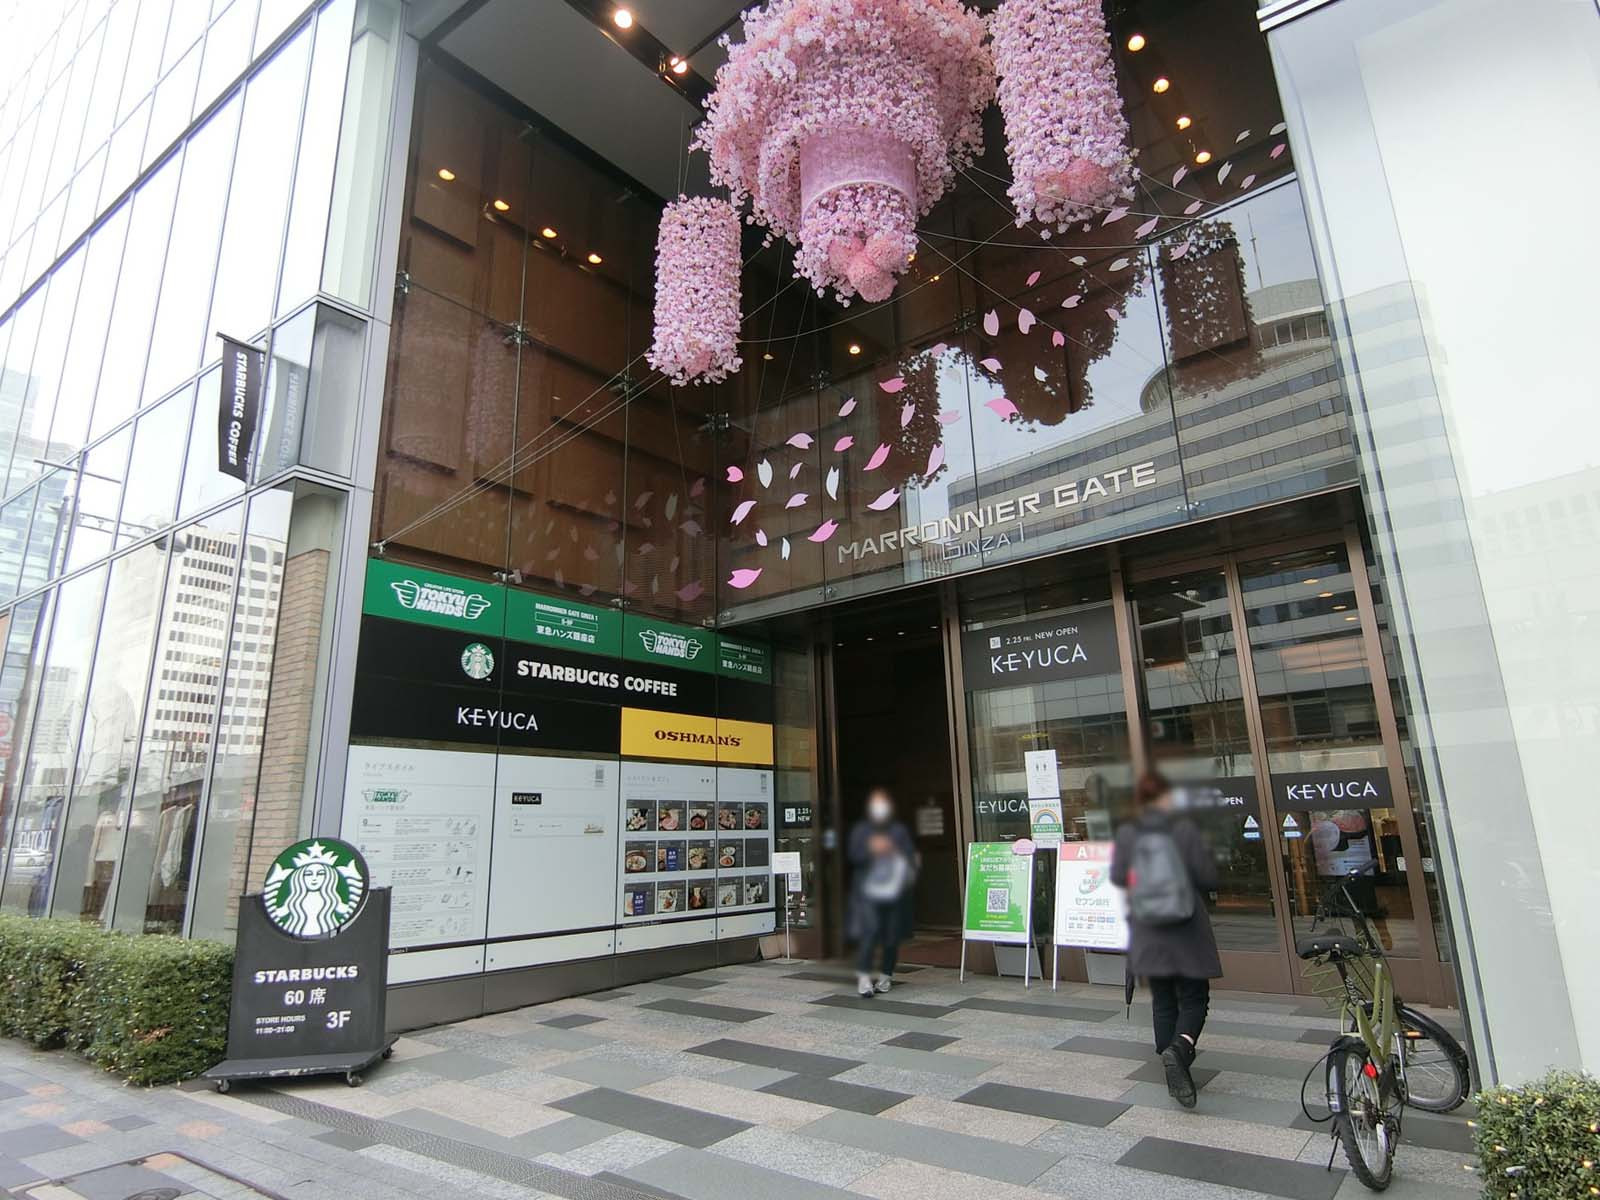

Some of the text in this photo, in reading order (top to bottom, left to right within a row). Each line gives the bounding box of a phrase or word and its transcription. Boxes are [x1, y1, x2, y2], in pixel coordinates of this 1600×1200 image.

[228, 352, 248, 466] STARBUCKS COFFEE
[837, 462, 1157, 564] MARRONNIER GATE
[942, 521, 1025, 560] GINZA 1
[421, 588, 466, 606] TOKYU
[416, 600, 463, 617] HANDS
[658, 635, 687, 648] TOKYU
[1006, 636, 1022, 645] 2.25
[1035, 631, 1054, 640] NEW
[1056, 626, 1078, 636] OPEN
[656, 645, 685, 658] HANDS
[991, 644, 1088, 674] KEYUCA
[517, 660, 678, 697] STARBUCKS COFFEE
[458, 707, 539, 731] KEYUCA
[655, 730, 741, 746] OSHMAN'S
[1286, 781, 1378, 800] KEYUCA
[978, 800, 1028, 813] EYUCA
[254, 966, 358, 983] STARBUCKS
[284, 987, 327, 1006] 60 席
[256, 1014, 306, 1025] STORE HOURS
[326, 1010, 351, 1029] 3F
